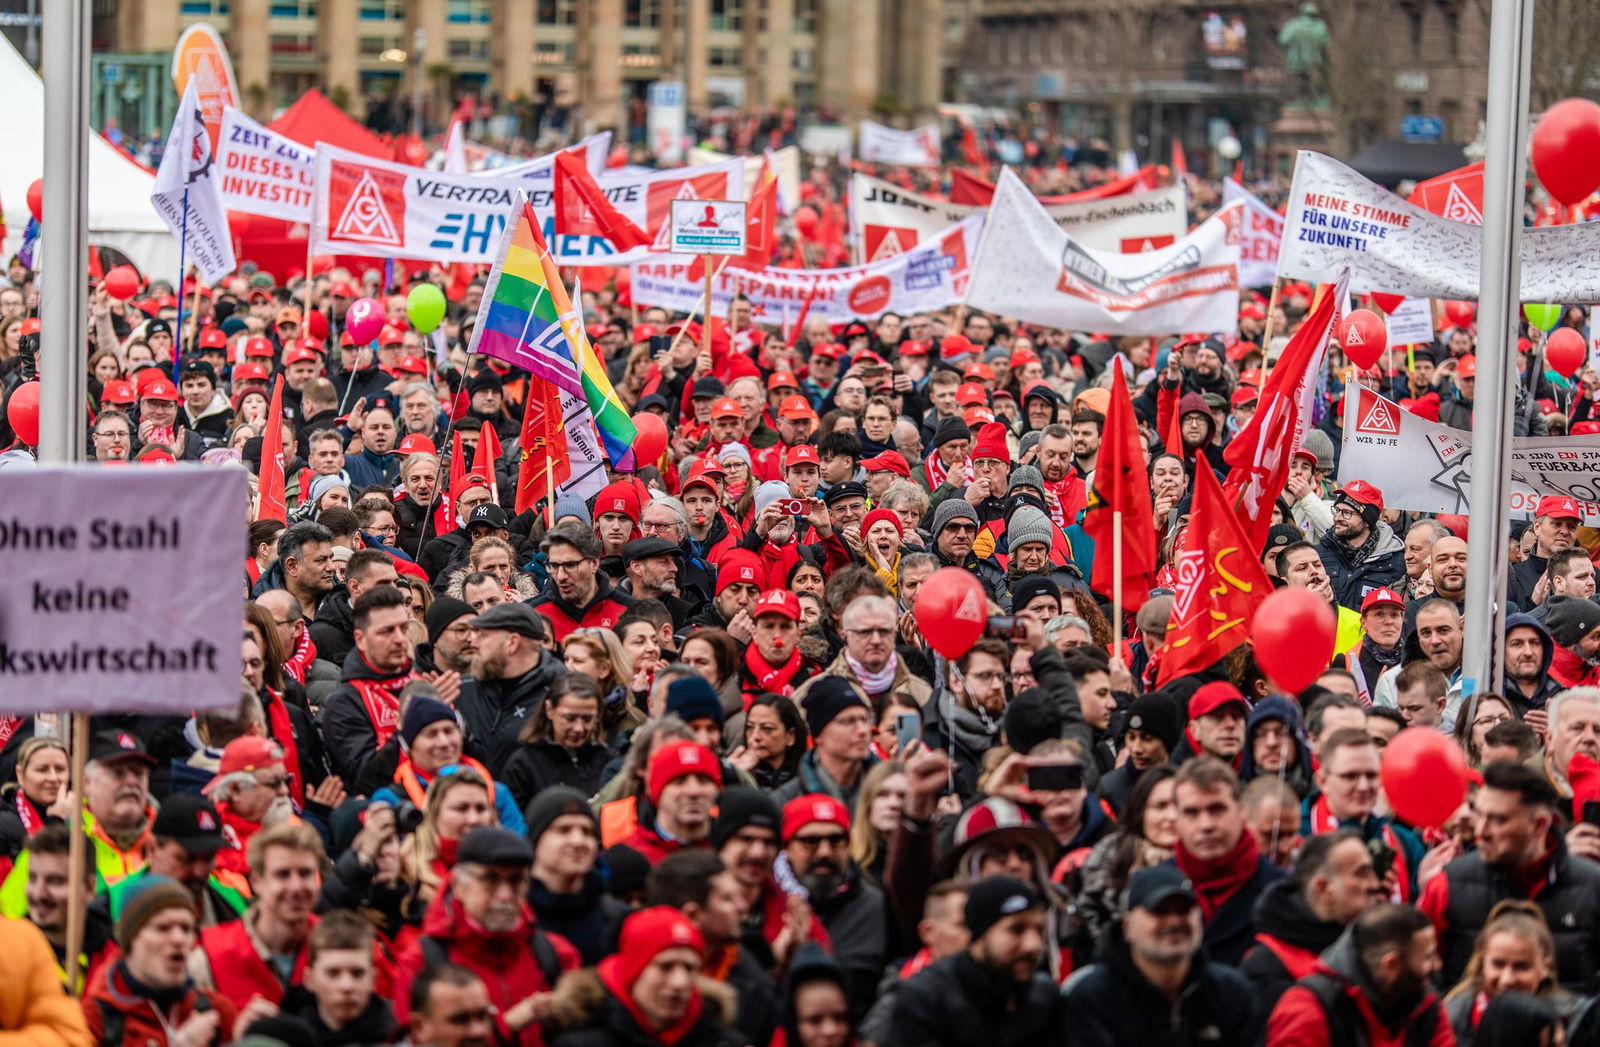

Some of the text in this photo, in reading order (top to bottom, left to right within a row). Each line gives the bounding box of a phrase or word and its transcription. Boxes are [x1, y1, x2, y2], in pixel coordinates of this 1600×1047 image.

[230, 125, 271, 149] ZEIT
[226, 152, 294, 180] DIESES
[222, 175, 312, 208] INVESTIT
[1302, 208, 1327, 226] FÜR
[1331, 215, 1388, 239] UNSERE
[1304, 192, 1411, 228] MEINE STIMME
[1298, 227, 1368, 251] ZUKUNFT!
[568, 426, 595, 462] sismus
[1356, 435, 1398, 447] WIR IN FE
[1441, 445, 1456, 457] EIN
[1528, 452, 1555, 460] SIND
[1557, 451, 1579, 460] EIN
[89, 517, 180, 551] Stahl
[32, 580, 130, 612] keine
[0, 640, 219, 675] kswirtschaft
